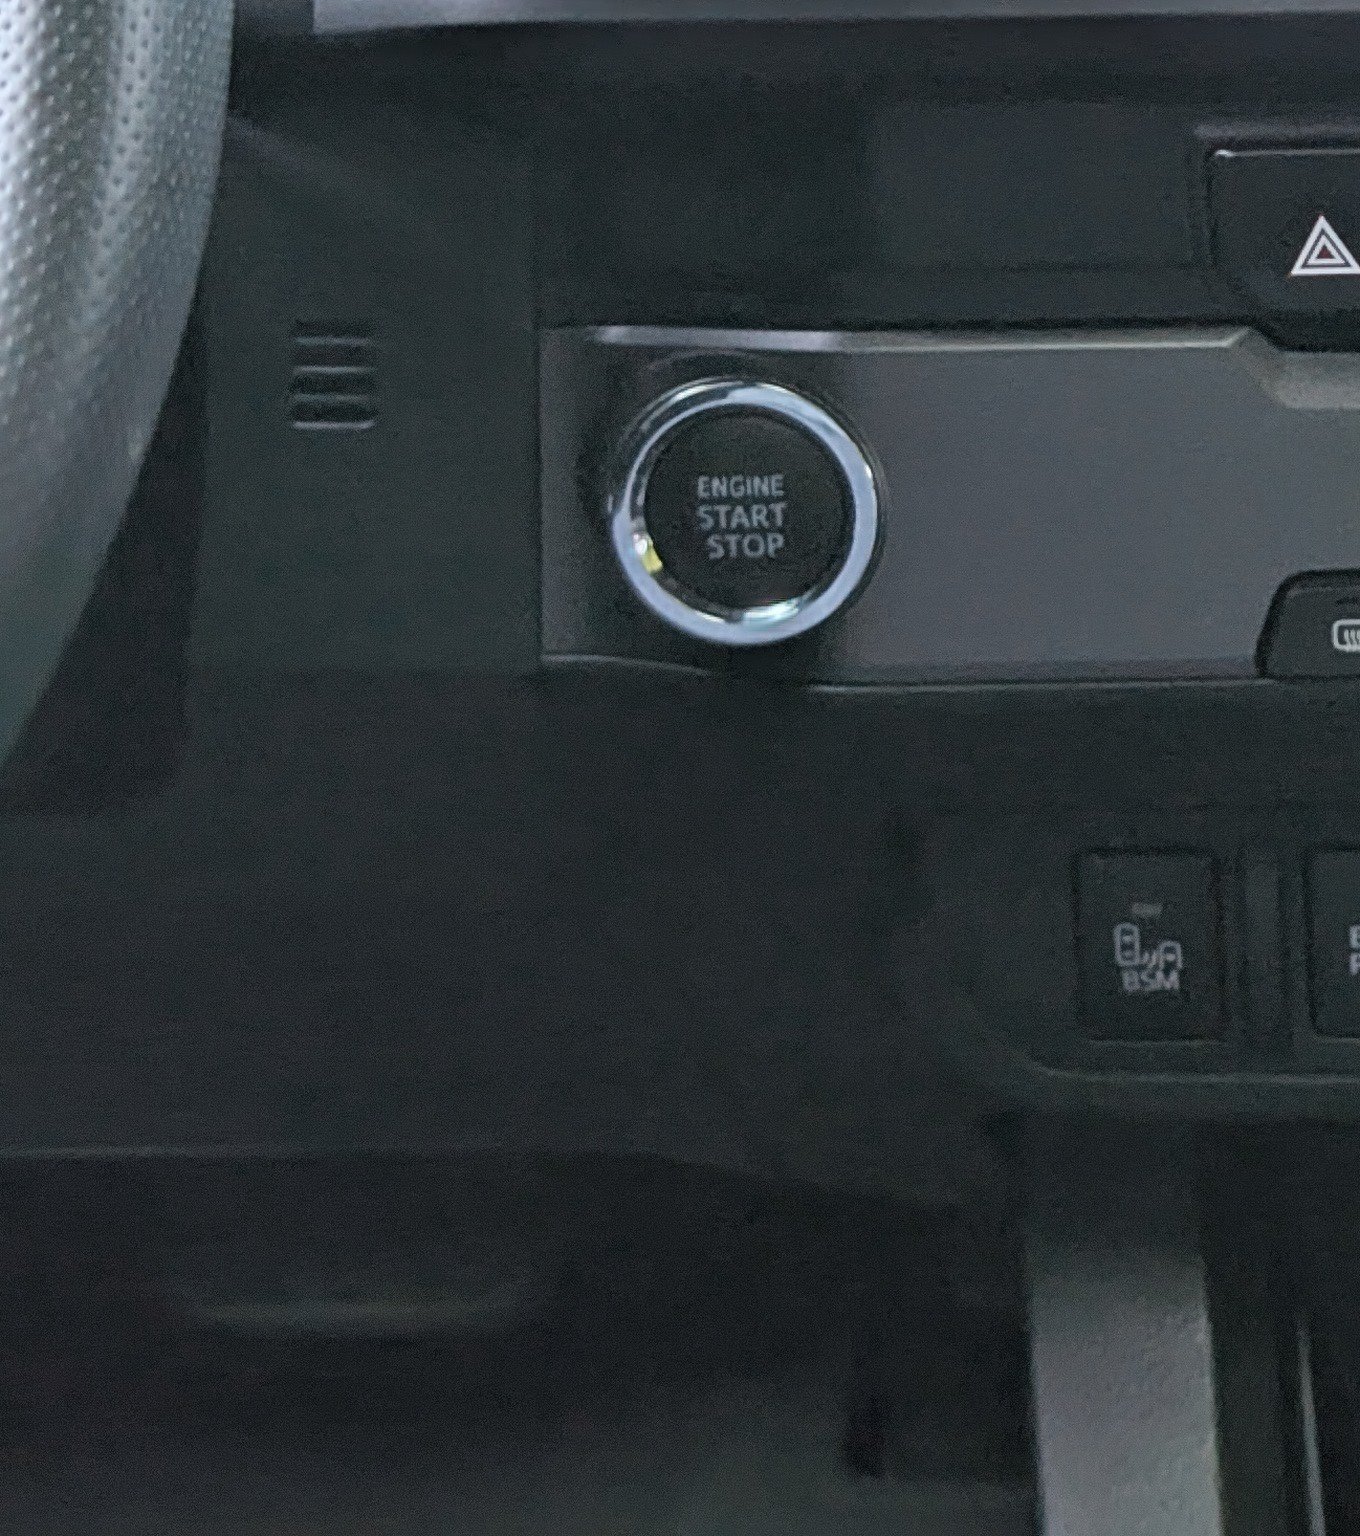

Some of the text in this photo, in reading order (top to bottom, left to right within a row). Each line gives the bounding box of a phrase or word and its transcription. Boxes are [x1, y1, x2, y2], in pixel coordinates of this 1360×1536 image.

[697, 474, 785, 498] ENGINE
[697, 503, 788, 530] START
[708, 533, 785, 560] STOP
[1121, 970, 1180, 992] BSM
